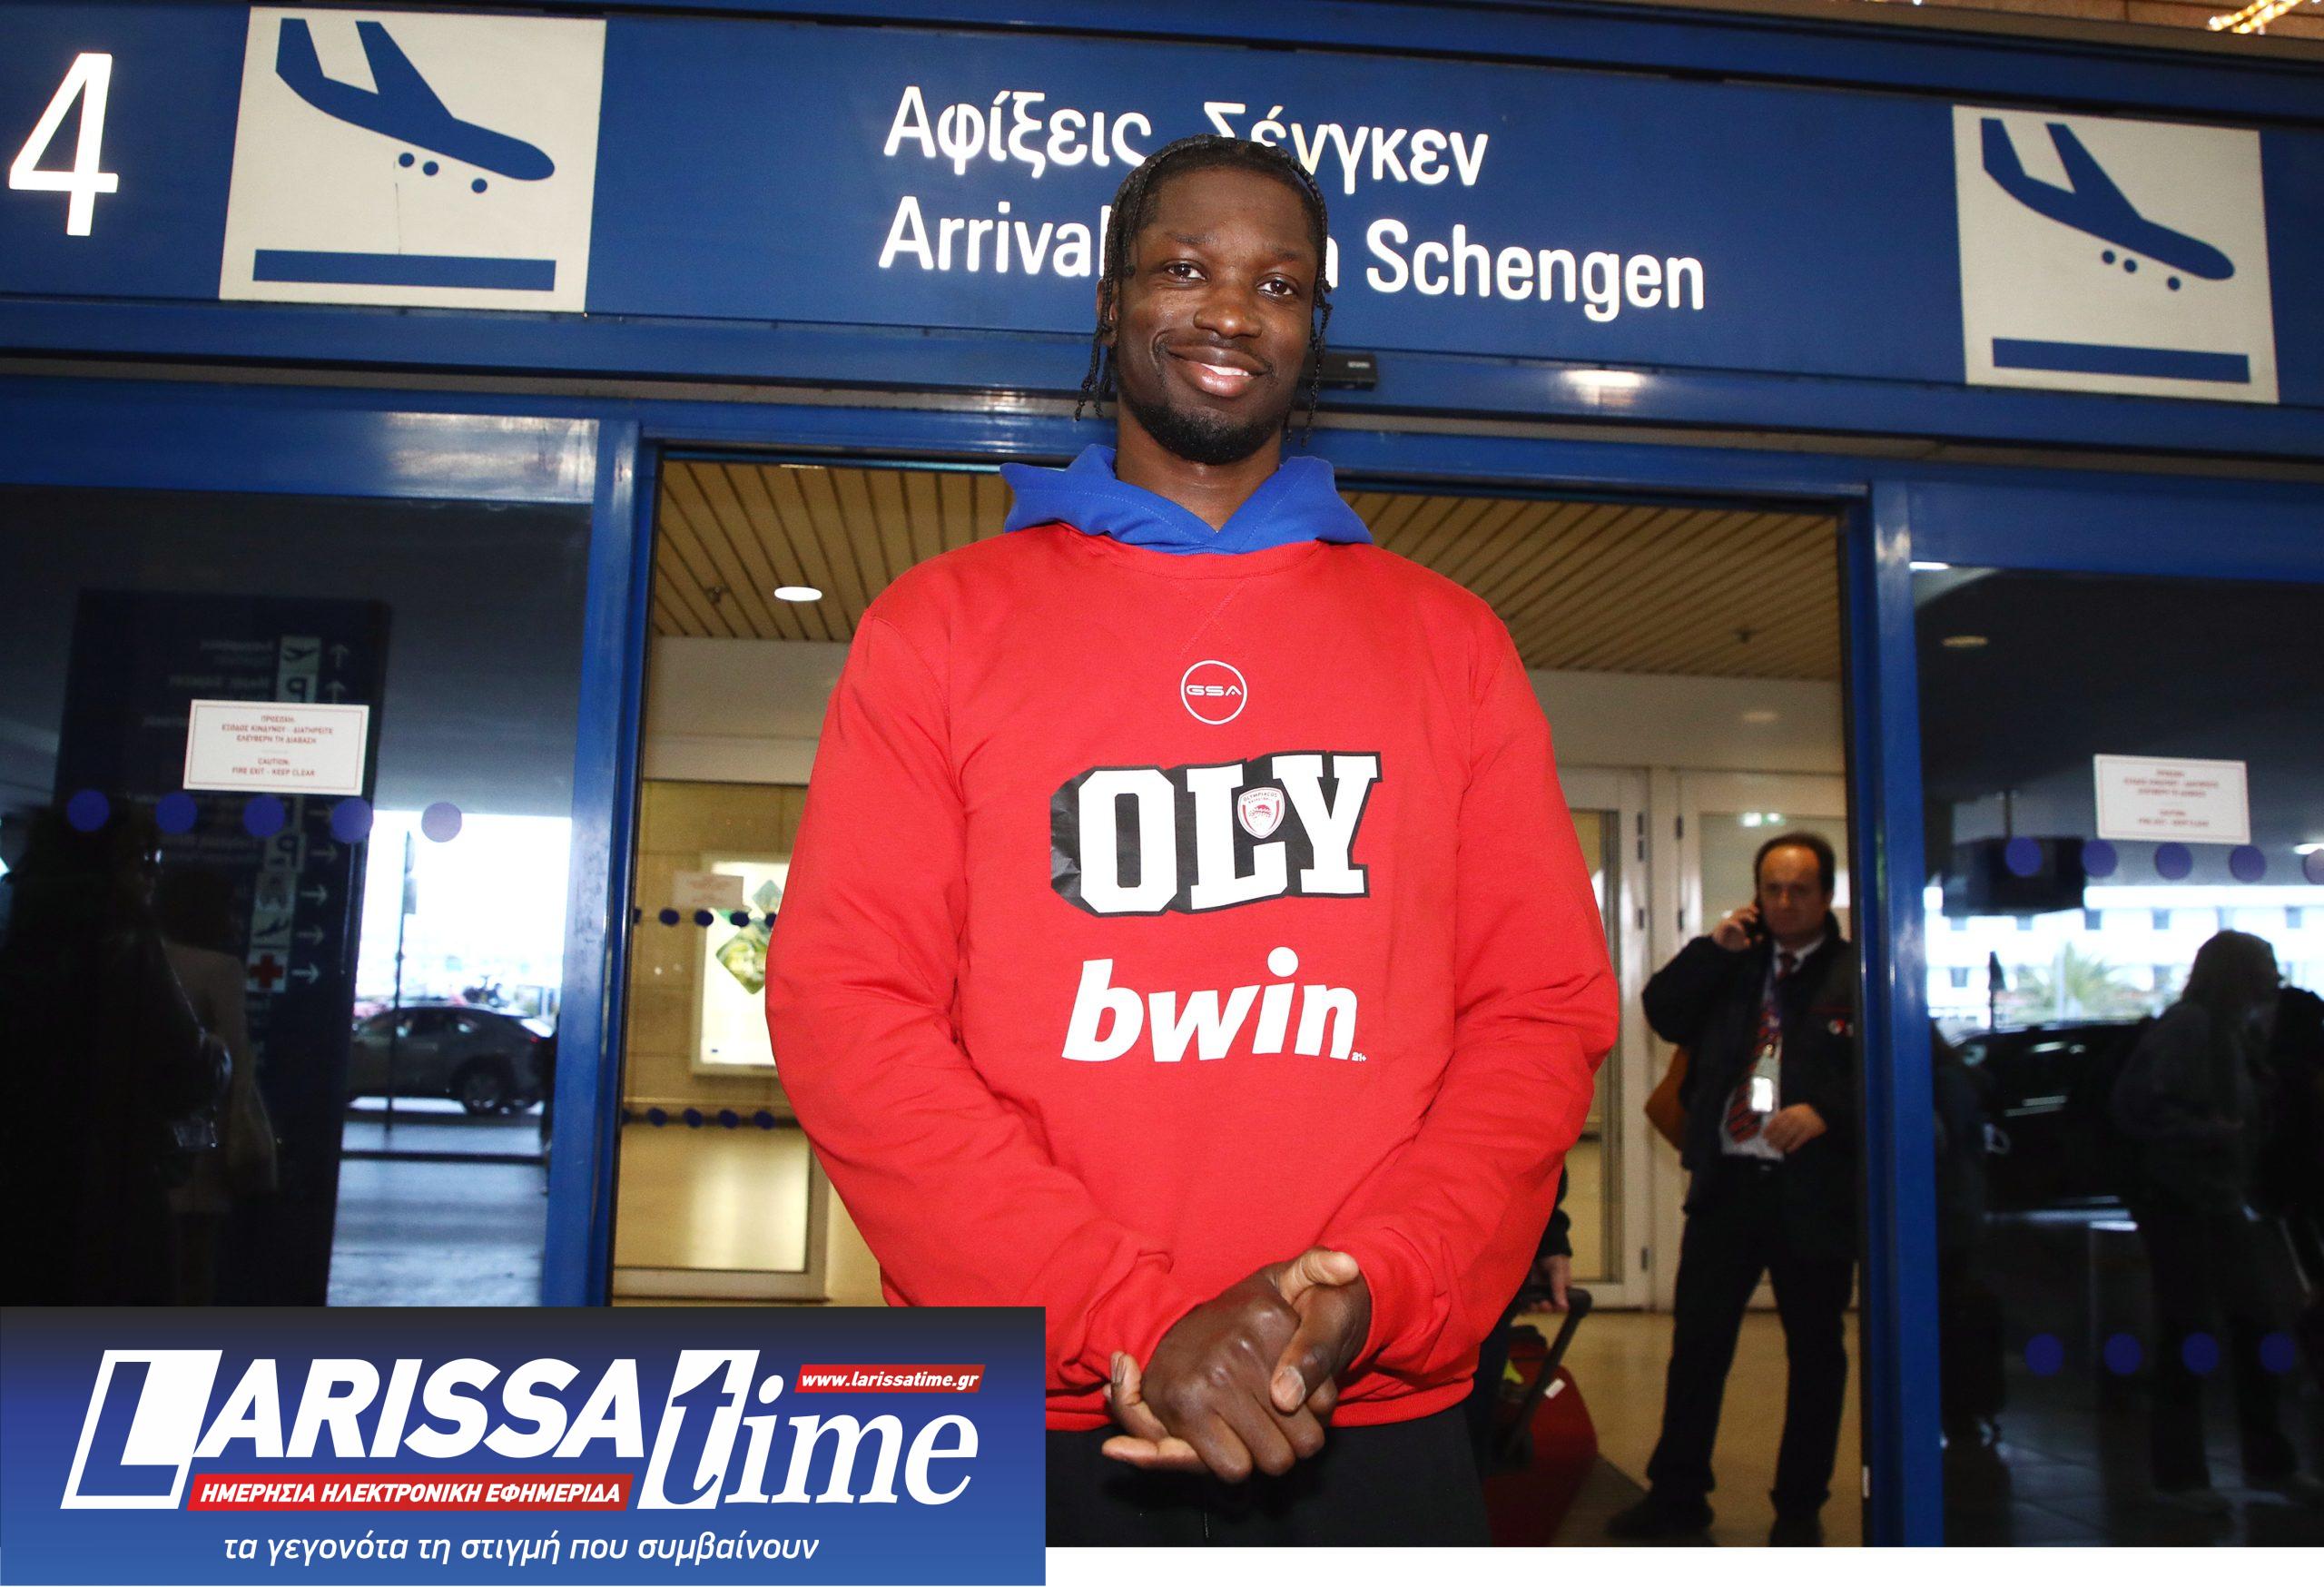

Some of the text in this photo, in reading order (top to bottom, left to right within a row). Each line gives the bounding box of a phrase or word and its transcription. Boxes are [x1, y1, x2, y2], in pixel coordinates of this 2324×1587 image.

[8, 53, 119, 237] 4
[883, 85, 1153, 180] Αφίξεις
[1366, 218, 1704, 323] Schengen
[1186, 685, 1243, 697] GSA
[1078, 754, 1379, 913] OLY
[1061, 946, 1358, 1063] bwin
